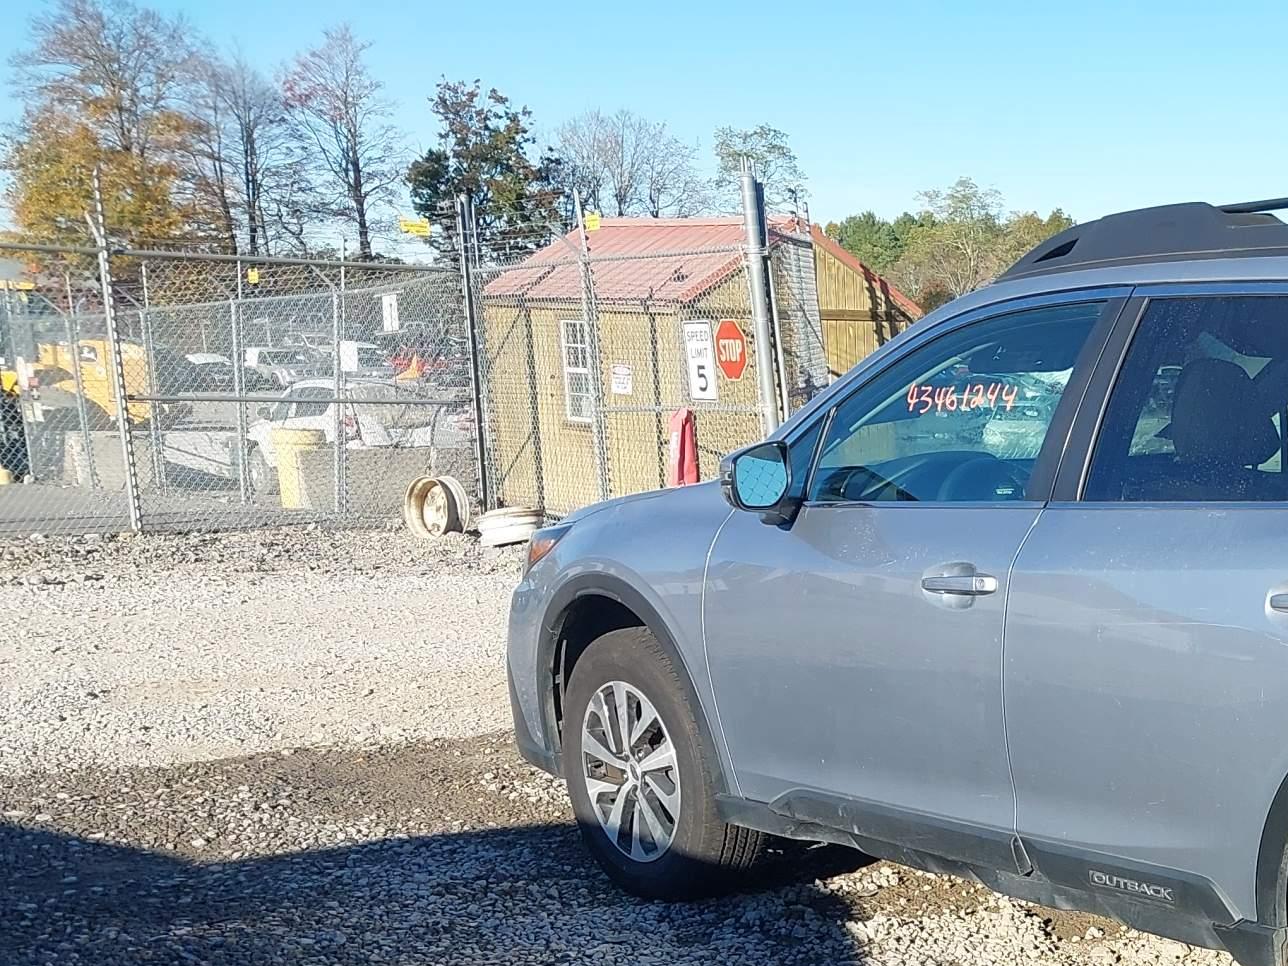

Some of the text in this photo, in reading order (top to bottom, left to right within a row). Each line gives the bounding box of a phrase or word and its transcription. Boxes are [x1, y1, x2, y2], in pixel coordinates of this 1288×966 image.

[686, 330, 709, 342] SPEED
[690, 347, 708, 359] LIMIT
[719, 339, 742, 362] STOP
[697, 365, 708, 392] 5
[907, 383, 1018, 413] 43461244
[1093, 871, 1174, 901] OUTBACK
